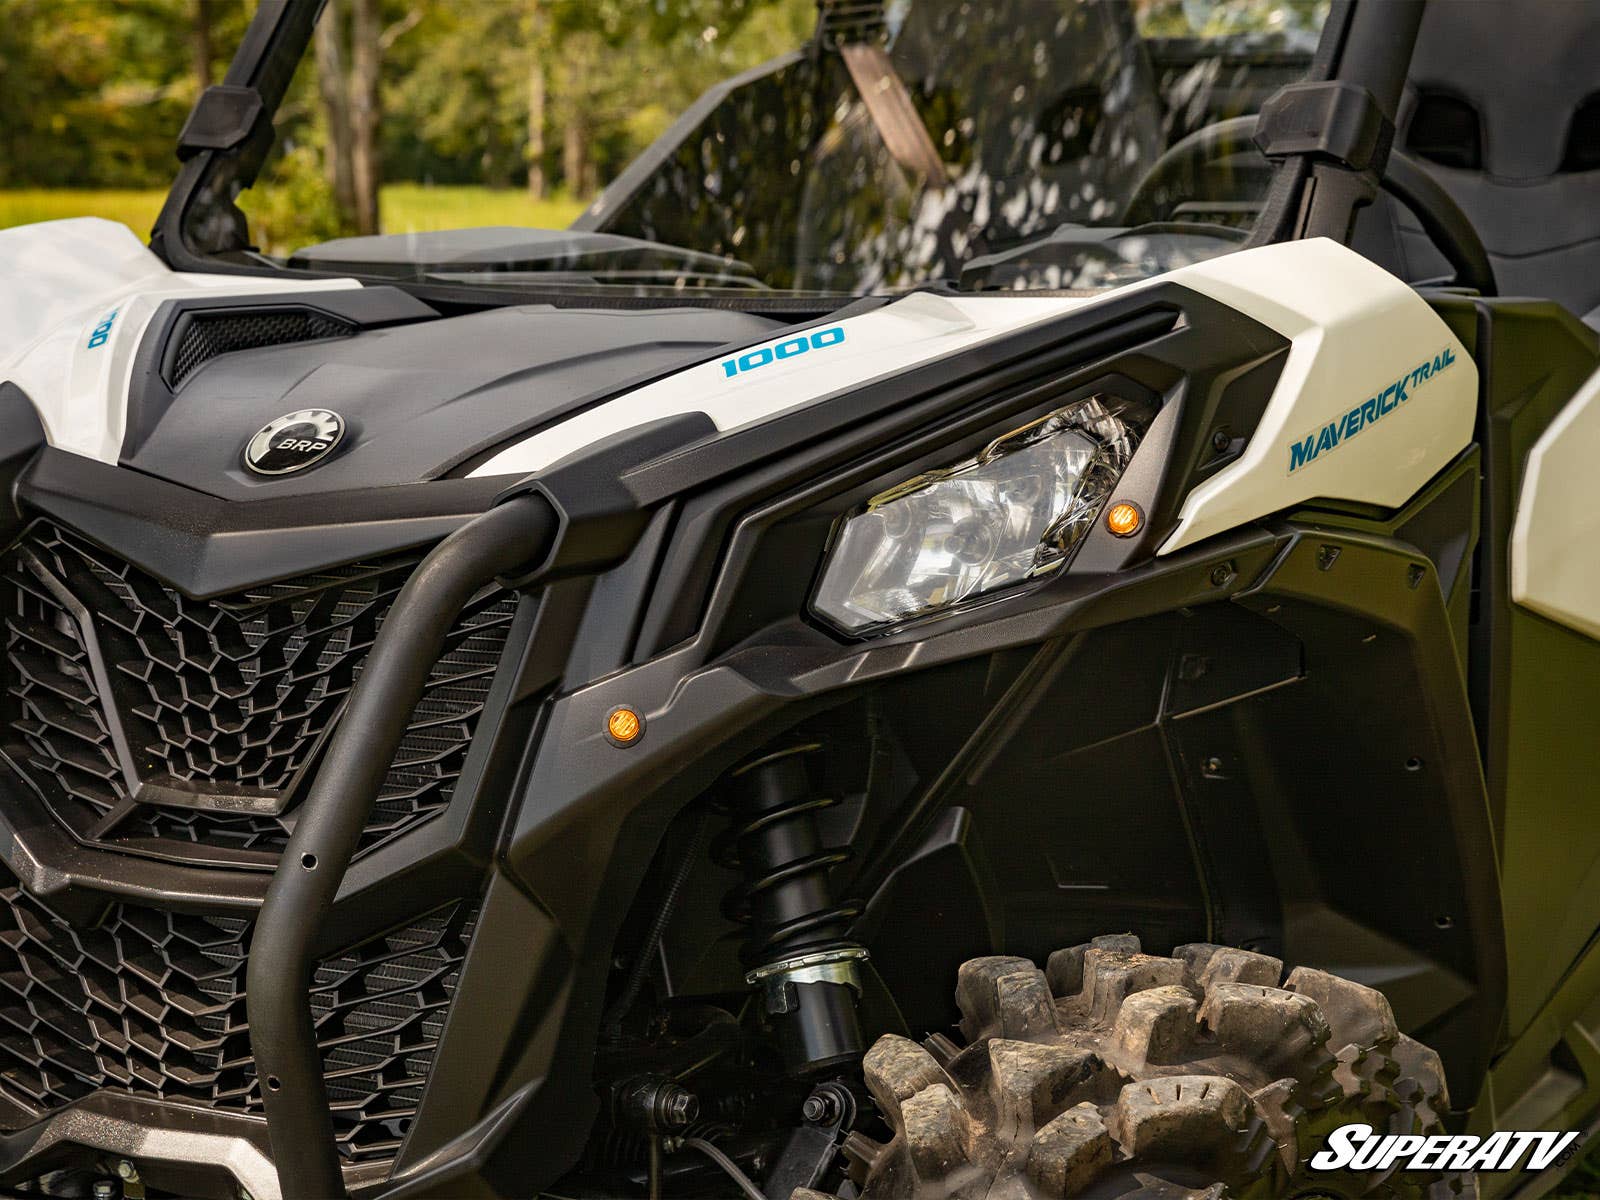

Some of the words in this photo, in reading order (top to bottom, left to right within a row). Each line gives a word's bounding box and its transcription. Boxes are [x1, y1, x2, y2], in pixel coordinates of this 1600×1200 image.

[722, 327, 845, 377] 1000
[1289, 375, 1410, 471] MAVERICK
[1411, 348, 1456, 388] TRAIL
[276, 439, 327, 452] BRP
